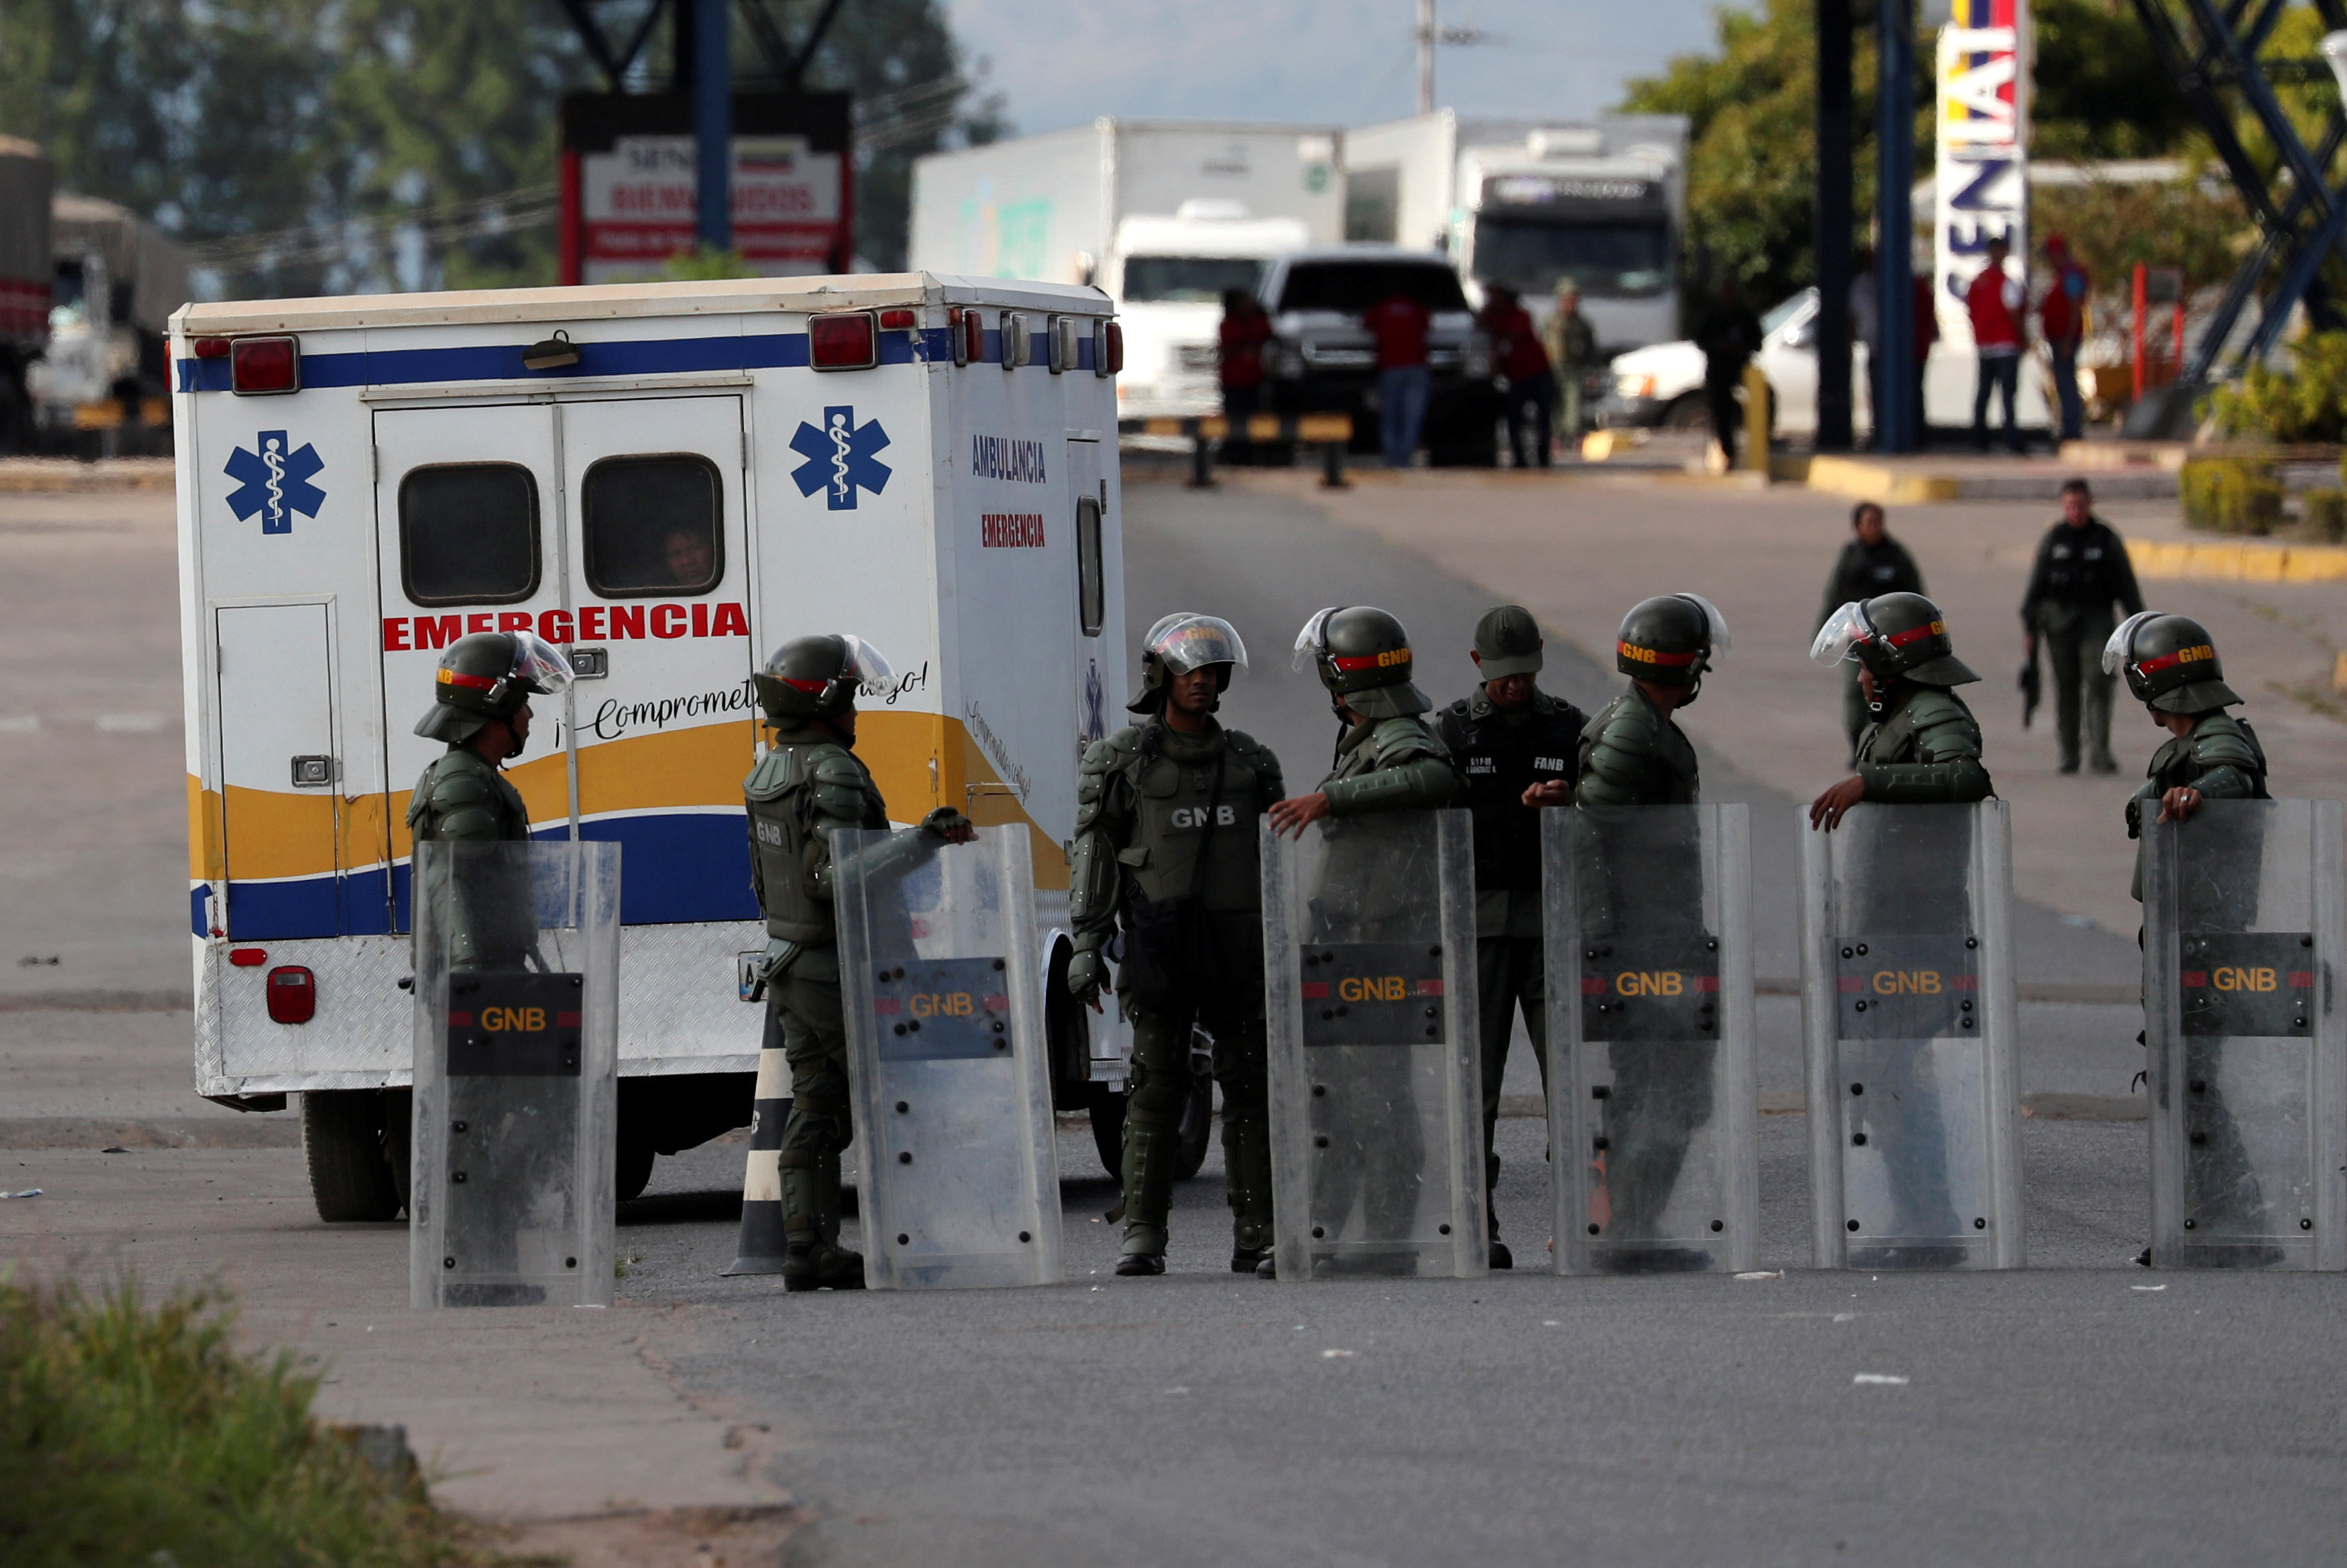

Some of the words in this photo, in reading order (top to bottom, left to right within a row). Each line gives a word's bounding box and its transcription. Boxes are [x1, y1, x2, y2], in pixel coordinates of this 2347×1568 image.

[973, 434, 1046, 483] AMBULANCIA
[982, 513, 1045, 548] EMERGENCIA
[383, 603, 750, 652] EMERGENCIA
[1186, 627, 1223, 642] GNB
[1378, 648, 1408, 667] GNB
[1623, 642, 1656, 664] GNB
[2179, 645, 2214, 664] GNB
[437, 668, 453, 684] NB
[1534, 757, 1564, 771] FANB
[1171, 805, 1235, 828] GNB
[756, 821, 782, 846] GNB
[1339, 976, 1406, 1002] GNB
[1616, 971, 1683, 997] GNB
[1872, 970, 1942, 995] GNB
[2213, 967, 2277, 991] GNB
[910, 992, 974, 1017] GNB
[481, 1006, 547, 1032] GNB
